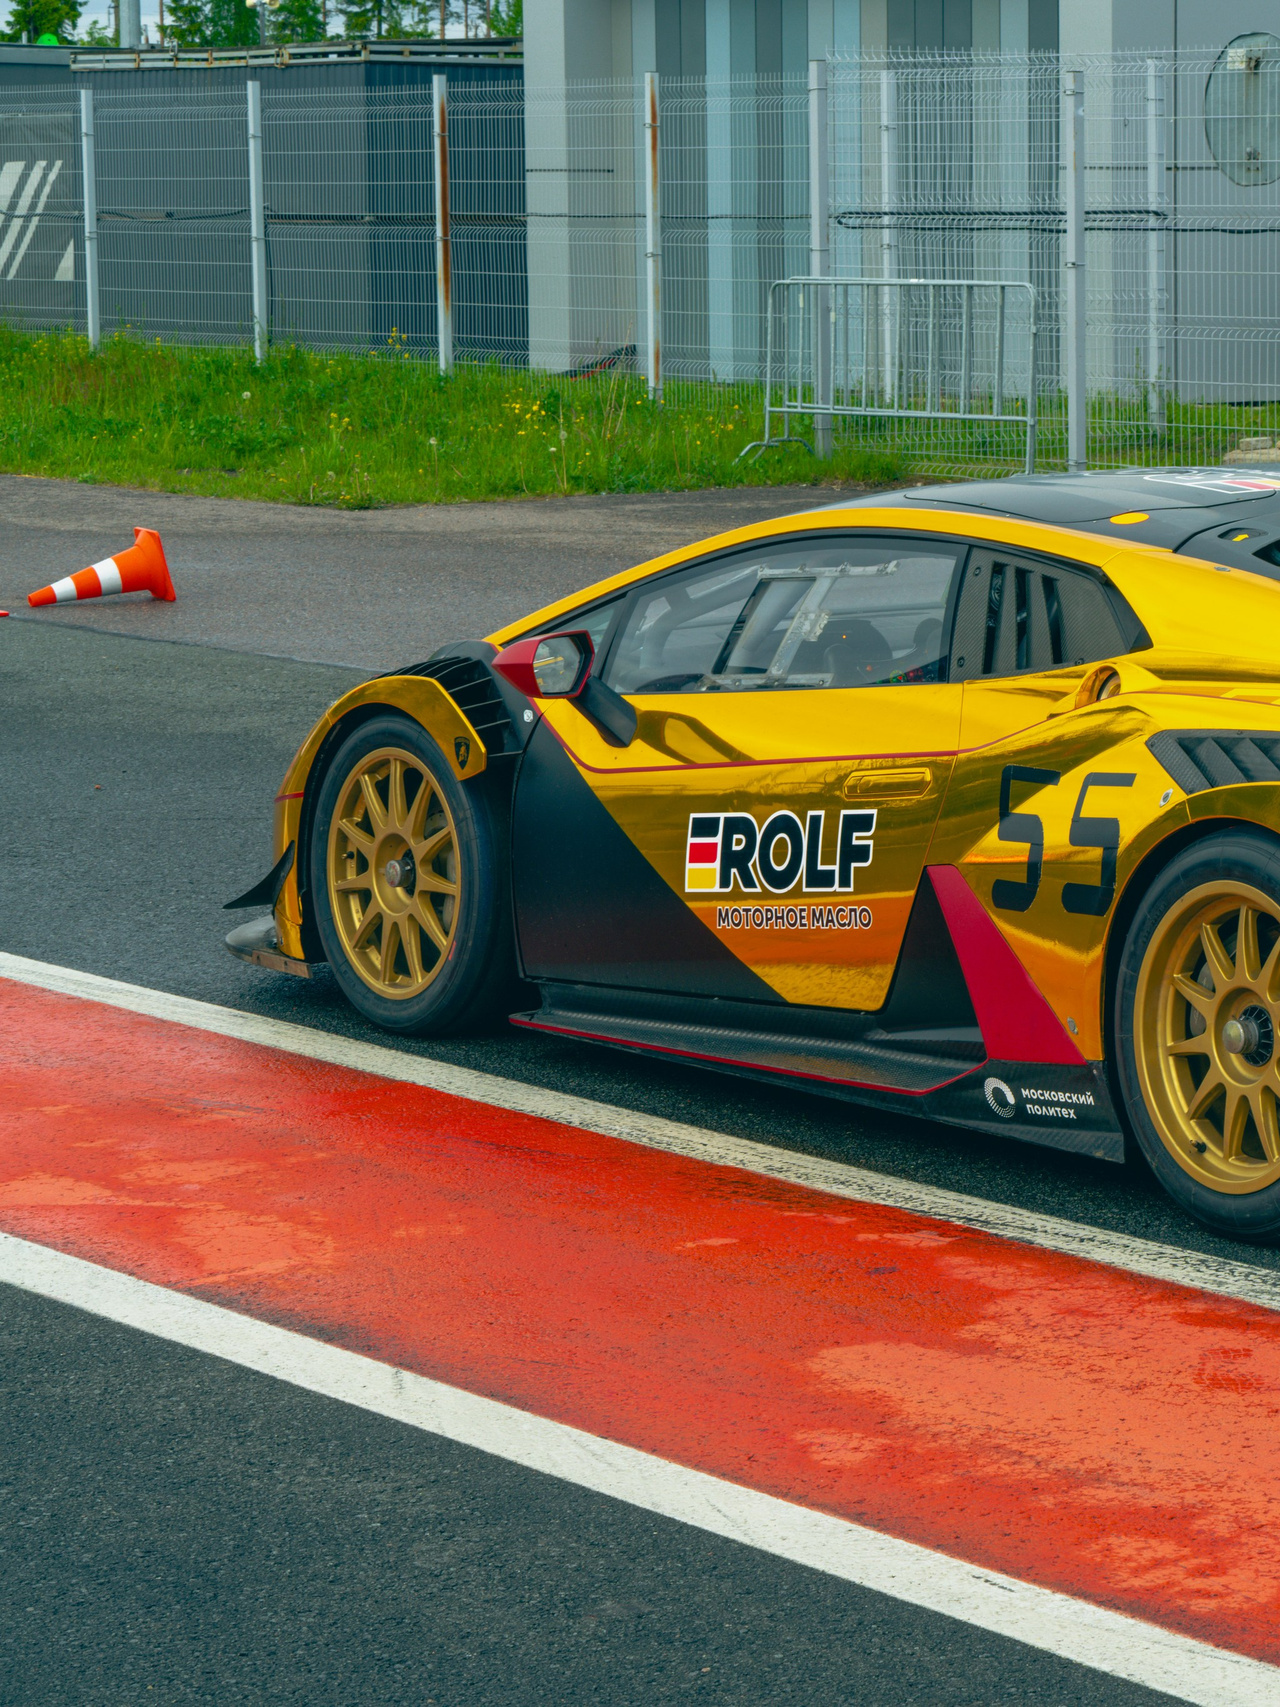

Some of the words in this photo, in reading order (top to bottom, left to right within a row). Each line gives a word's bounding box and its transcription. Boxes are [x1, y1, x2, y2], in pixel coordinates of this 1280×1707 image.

[717, 809, 878, 894] ROLF
[991, 764, 1138, 917] 55
[716, 906, 808, 929] МОТОРНОЕ
[810, 906, 872, 929] МАСЛО
